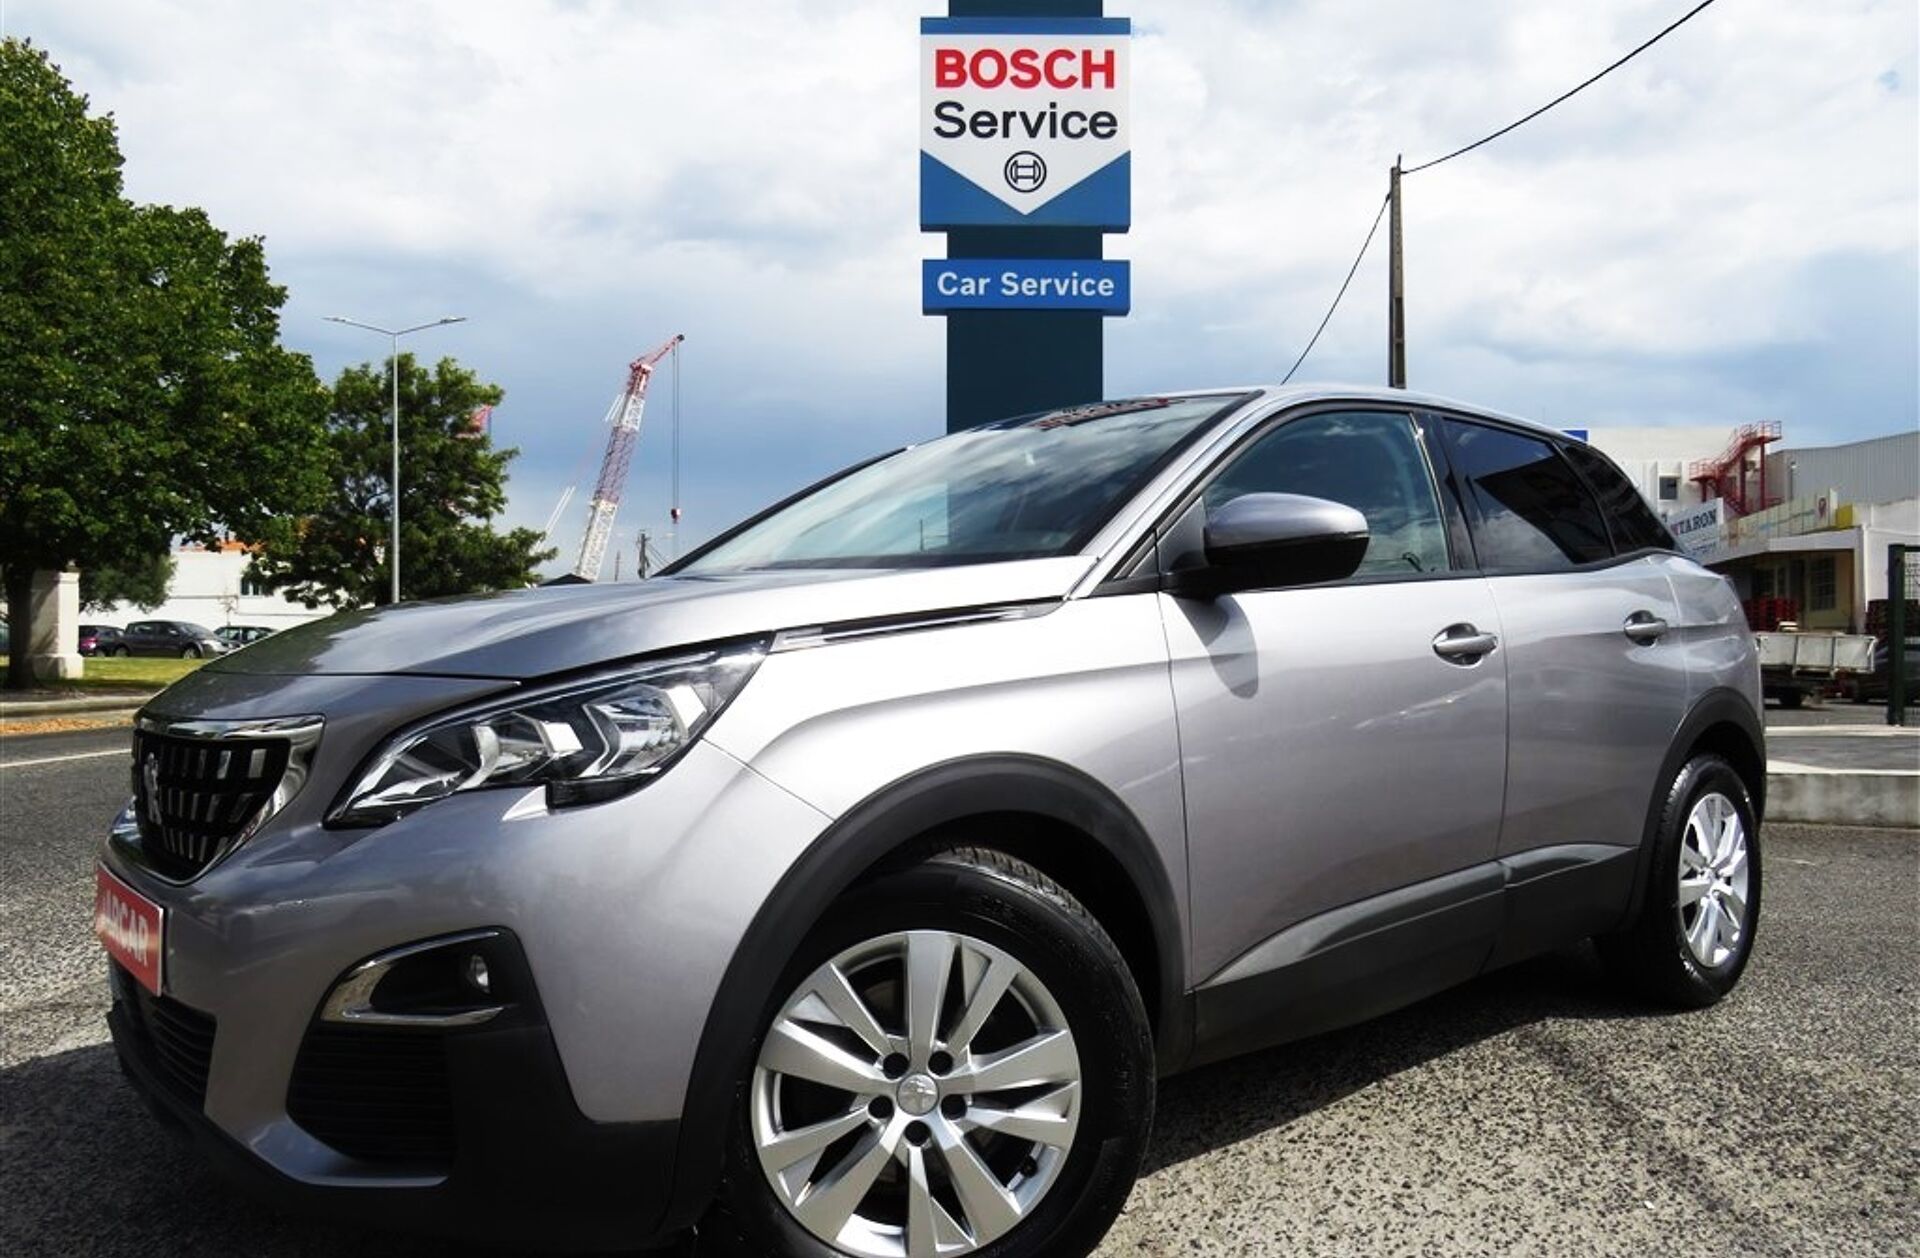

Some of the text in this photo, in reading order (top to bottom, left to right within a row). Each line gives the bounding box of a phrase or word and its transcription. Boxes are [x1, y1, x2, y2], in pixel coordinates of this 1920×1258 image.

[935, 49, 1115, 89] BOSCH
[933, 101, 1118, 139] Service
[937, 272, 1114, 296] Car Service
